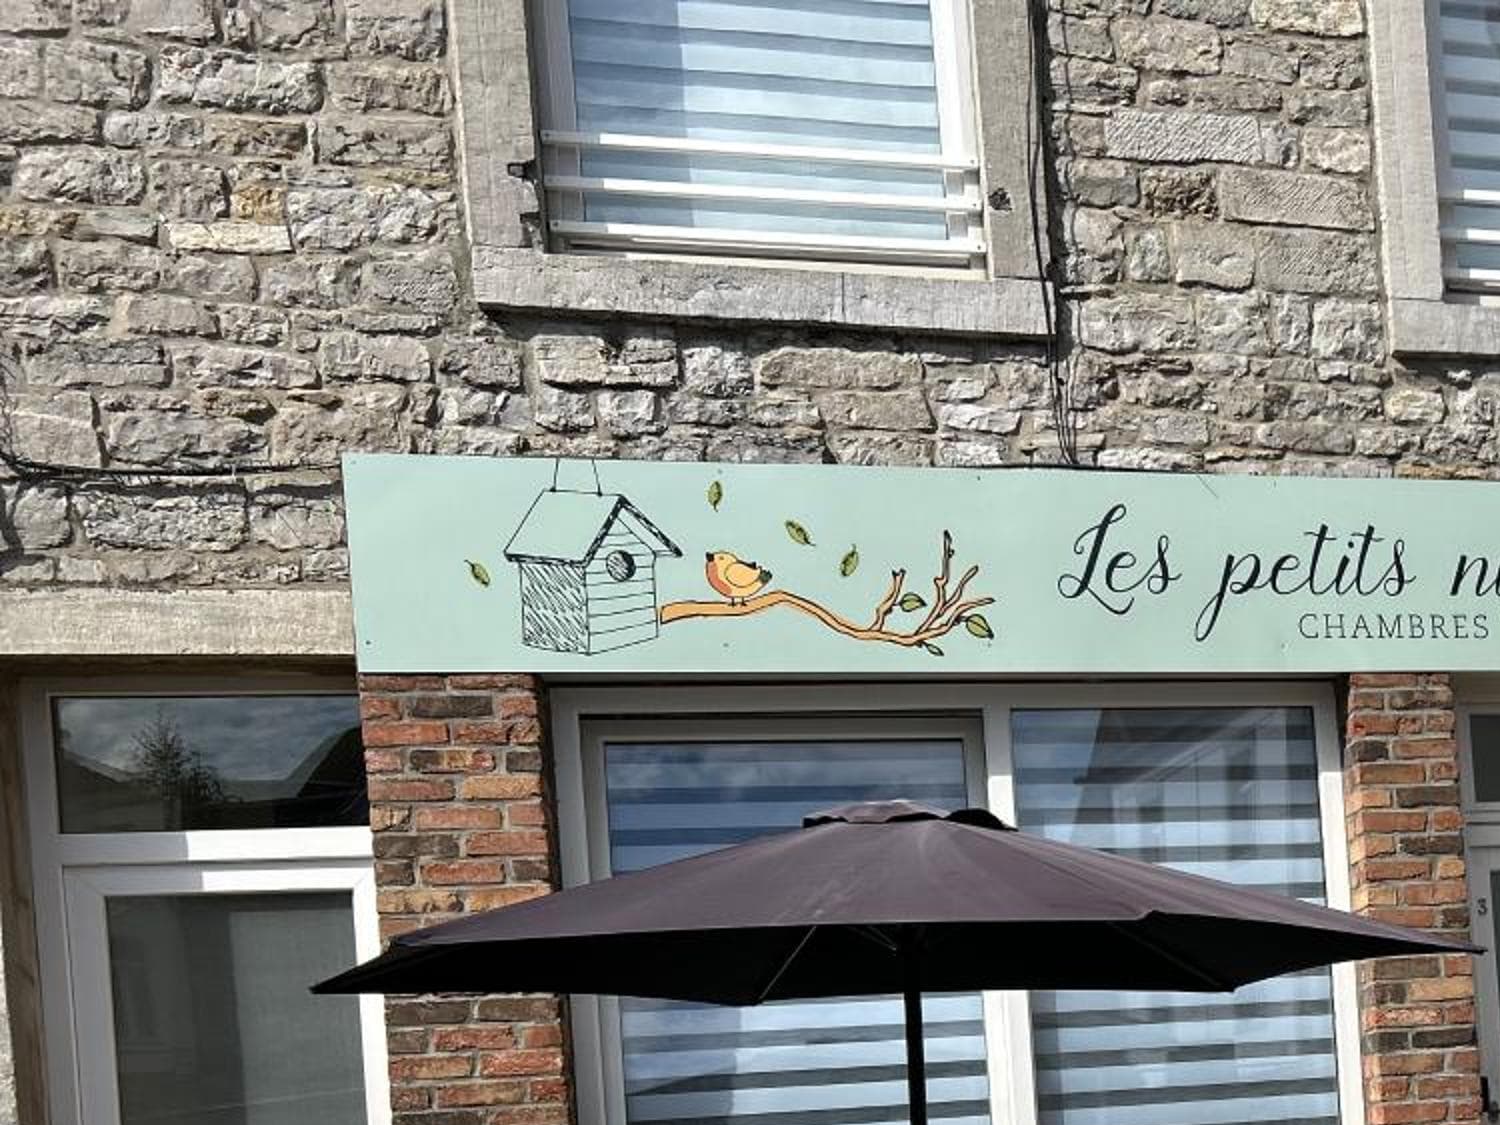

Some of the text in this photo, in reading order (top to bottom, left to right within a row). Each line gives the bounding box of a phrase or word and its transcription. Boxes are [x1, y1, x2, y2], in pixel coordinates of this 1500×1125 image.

[1057, 503, 1182, 615] Les
[1195, 523, 1417, 642] petits
[1298, 613, 1489, 640] CHAMBRES
[1477, 898, 1488, 917] 3
